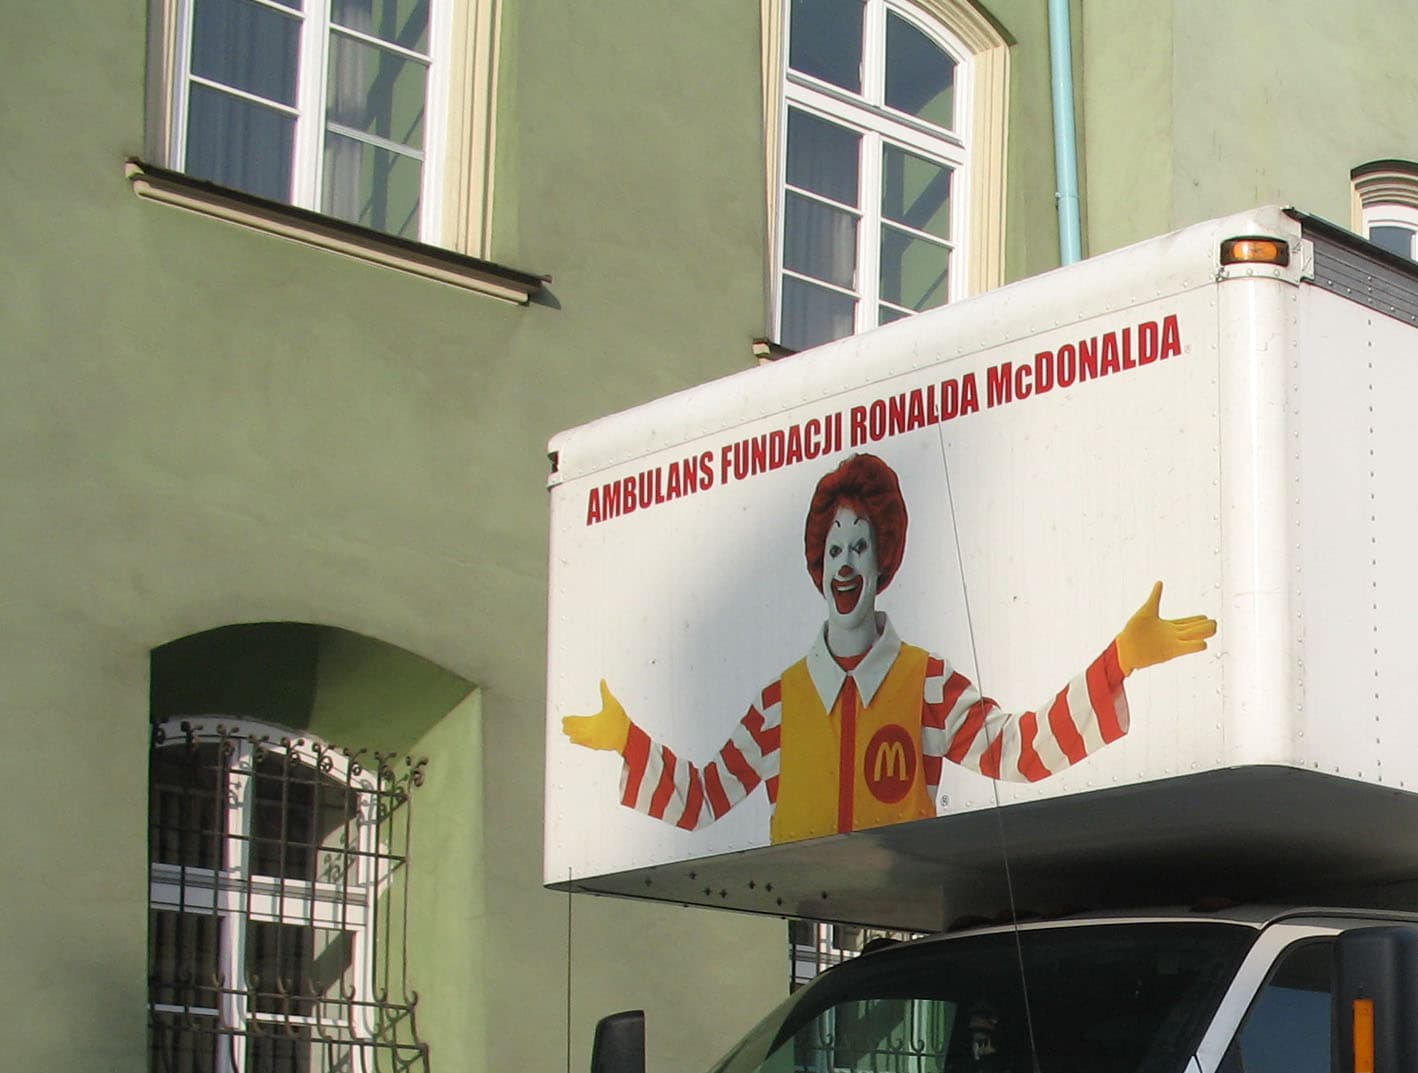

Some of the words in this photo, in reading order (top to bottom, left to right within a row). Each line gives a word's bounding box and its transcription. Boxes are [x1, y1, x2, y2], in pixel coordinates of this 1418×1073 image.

[586, 450, 715, 525] AMBULANS
[720, 411, 843, 486] FUNDACJI
[849, 371, 980, 447] RONALDA
[987, 313, 1182, 408] McDONALDA
